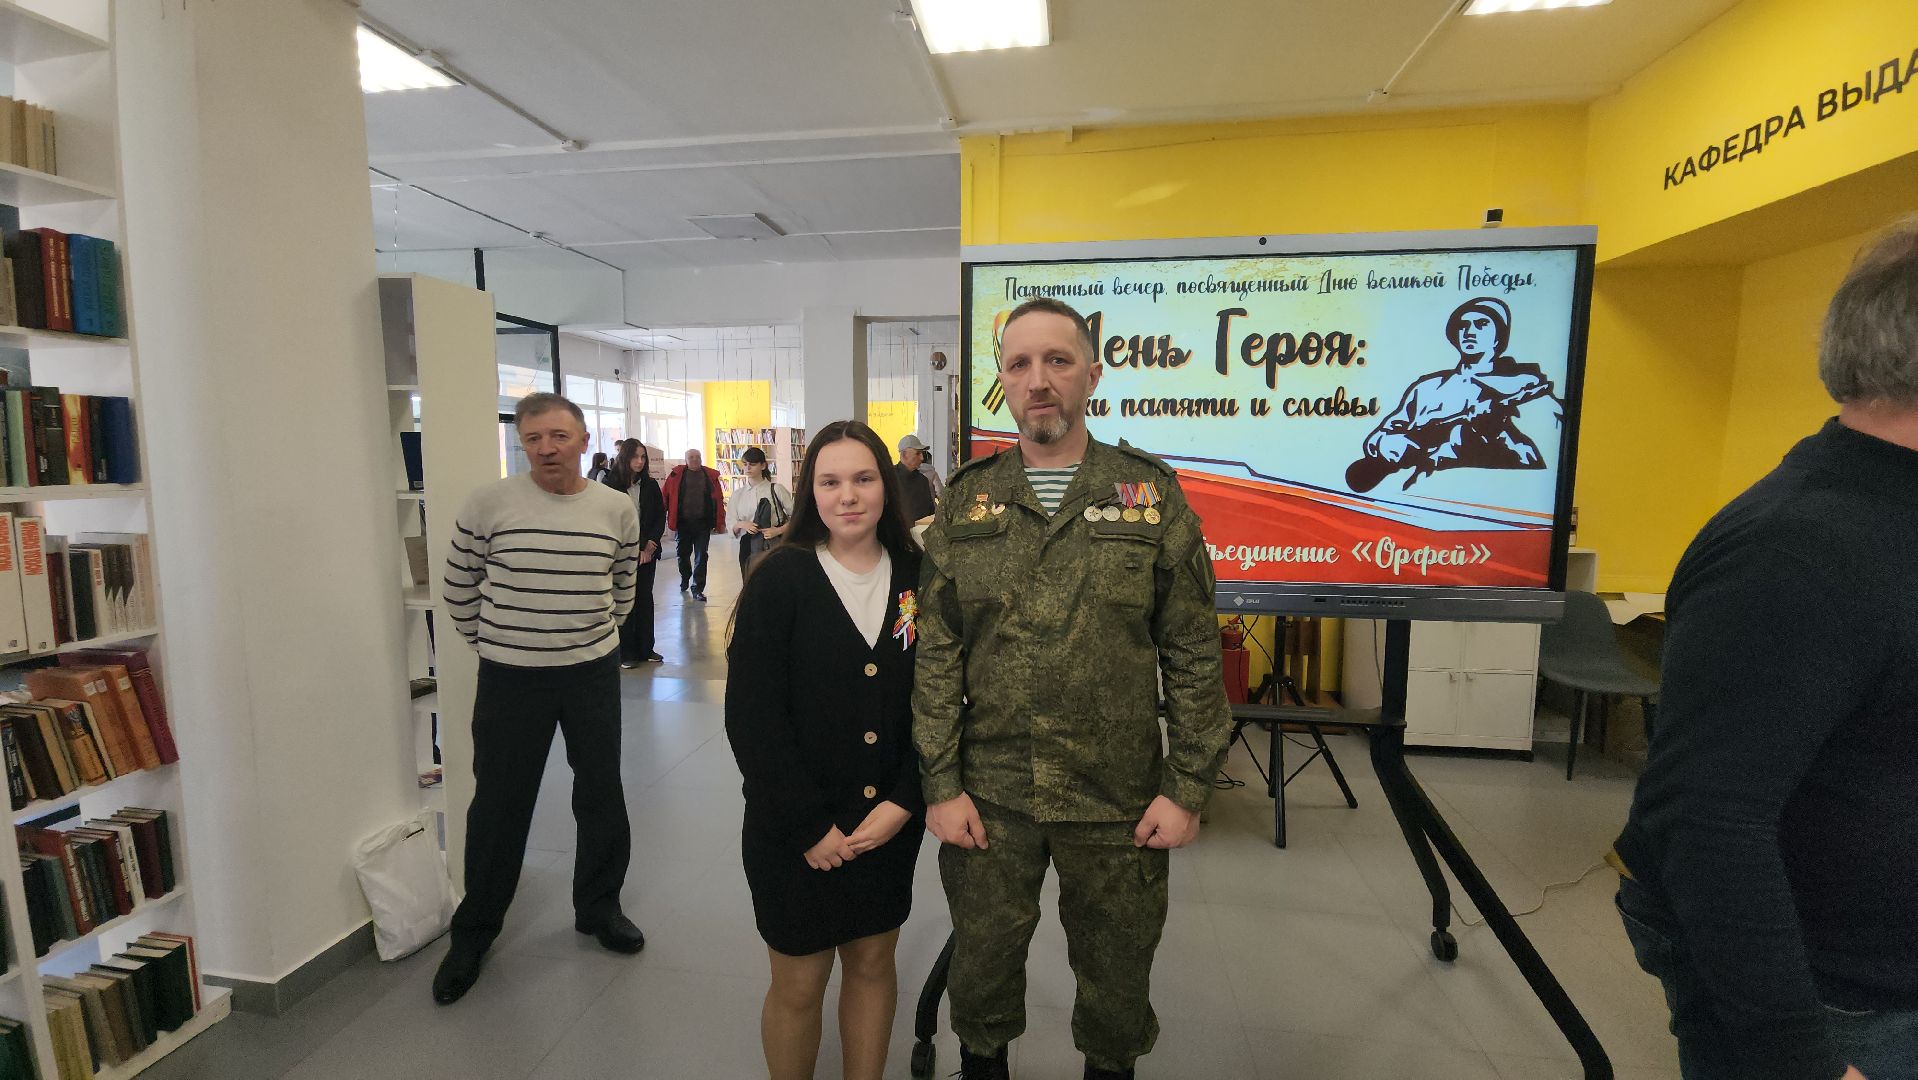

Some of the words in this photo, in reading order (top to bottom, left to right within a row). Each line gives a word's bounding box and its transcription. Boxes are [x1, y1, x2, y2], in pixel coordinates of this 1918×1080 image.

[1664, 105, 1806, 190] КАФЕДРА
[1005, 276, 1105, 301] Памятный
[1177, 274, 1309, 301] посвященный
[1317, 268, 1358, 295] Дню
[1366, 270, 1447, 290] великой
[1215, 307, 1368, 390] Героя:
[1120, 397, 1240, 418] памяти
[1250, 397, 1270, 418] и
[1282, 386, 1381, 418] славы
[1202, 536, 1340, 571] ъединение
[1351, 535, 1492, 576] «Орфей»
